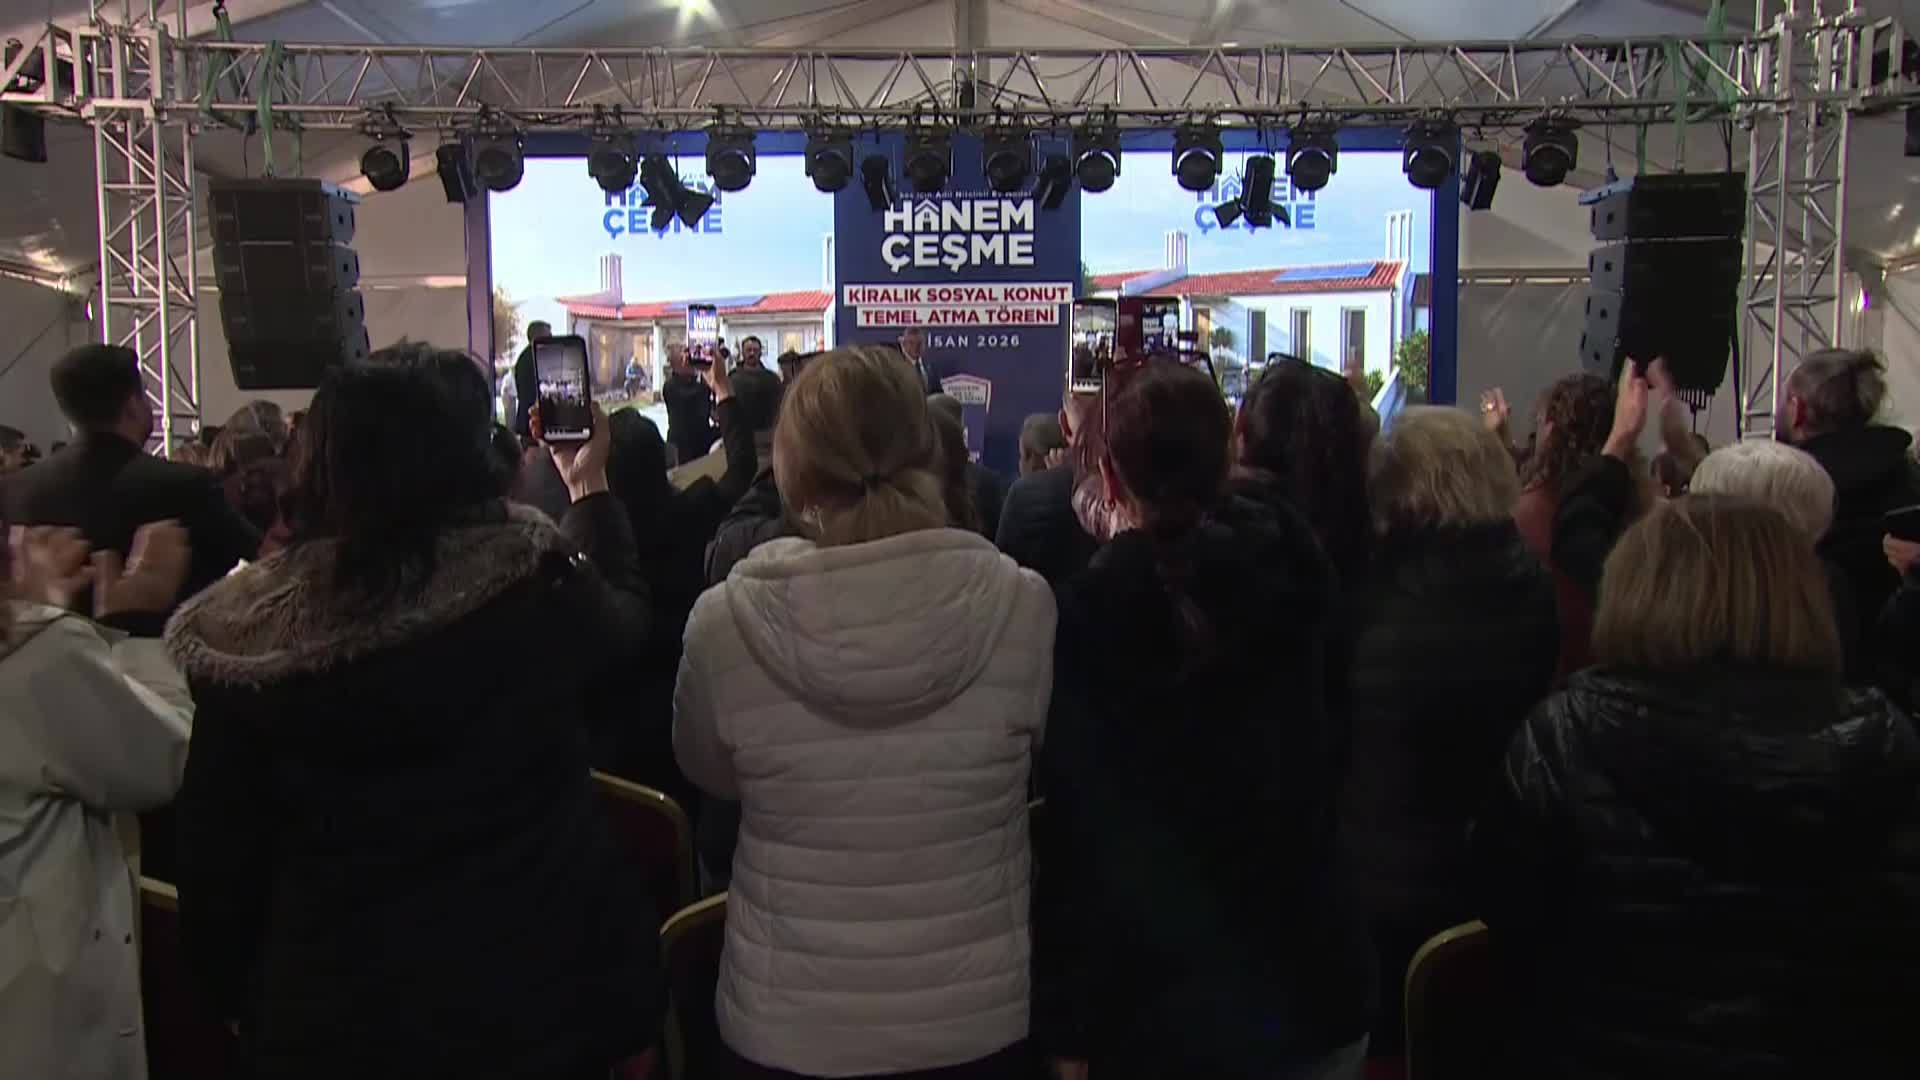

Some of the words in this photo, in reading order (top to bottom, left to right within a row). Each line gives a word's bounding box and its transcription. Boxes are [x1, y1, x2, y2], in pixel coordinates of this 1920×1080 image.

[603, 208, 723, 239] ÇEE
[882, 233, 1034, 272] ÇEŞME
[849, 285, 922, 303] KİRALIK
[927, 287, 998, 302] SOSYAL
[1003, 287, 1068, 302] KONUT
[862, 309, 923, 324] TEMEL
[927, 309, 980, 324] ATMA
[985, 305, 1055, 323] TÖRENİ
[927, 331, 969, 347] İSAN
[976, 334, 1020, 347] 2026
